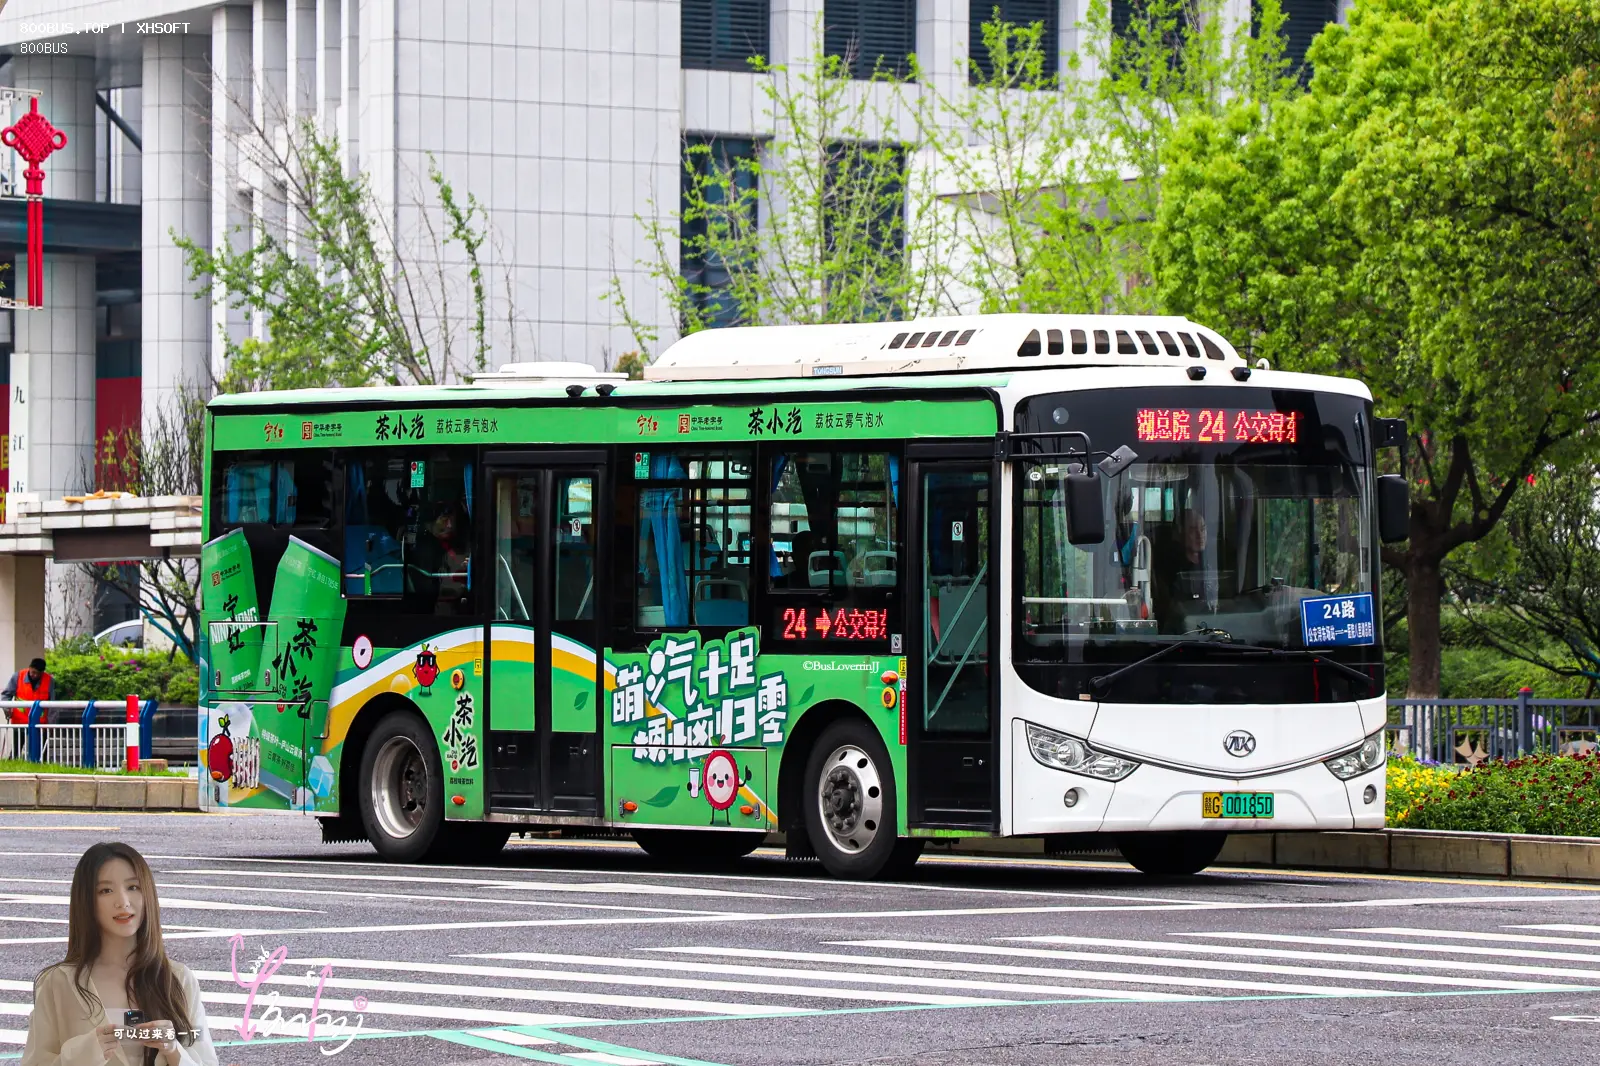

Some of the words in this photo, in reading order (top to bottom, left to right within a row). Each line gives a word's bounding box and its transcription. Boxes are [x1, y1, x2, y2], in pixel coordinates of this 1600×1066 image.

[436, 418, 499, 434] 荔枝云雾气泡水
[815, 411, 884, 429] 荔枝云雾气泡水
[1198, 410, 1226, 442] 24
[1323, 600, 1355, 619] 24路
[783, 608, 807, 639] 24
[613, 637, 755, 723] 萌汽十足
